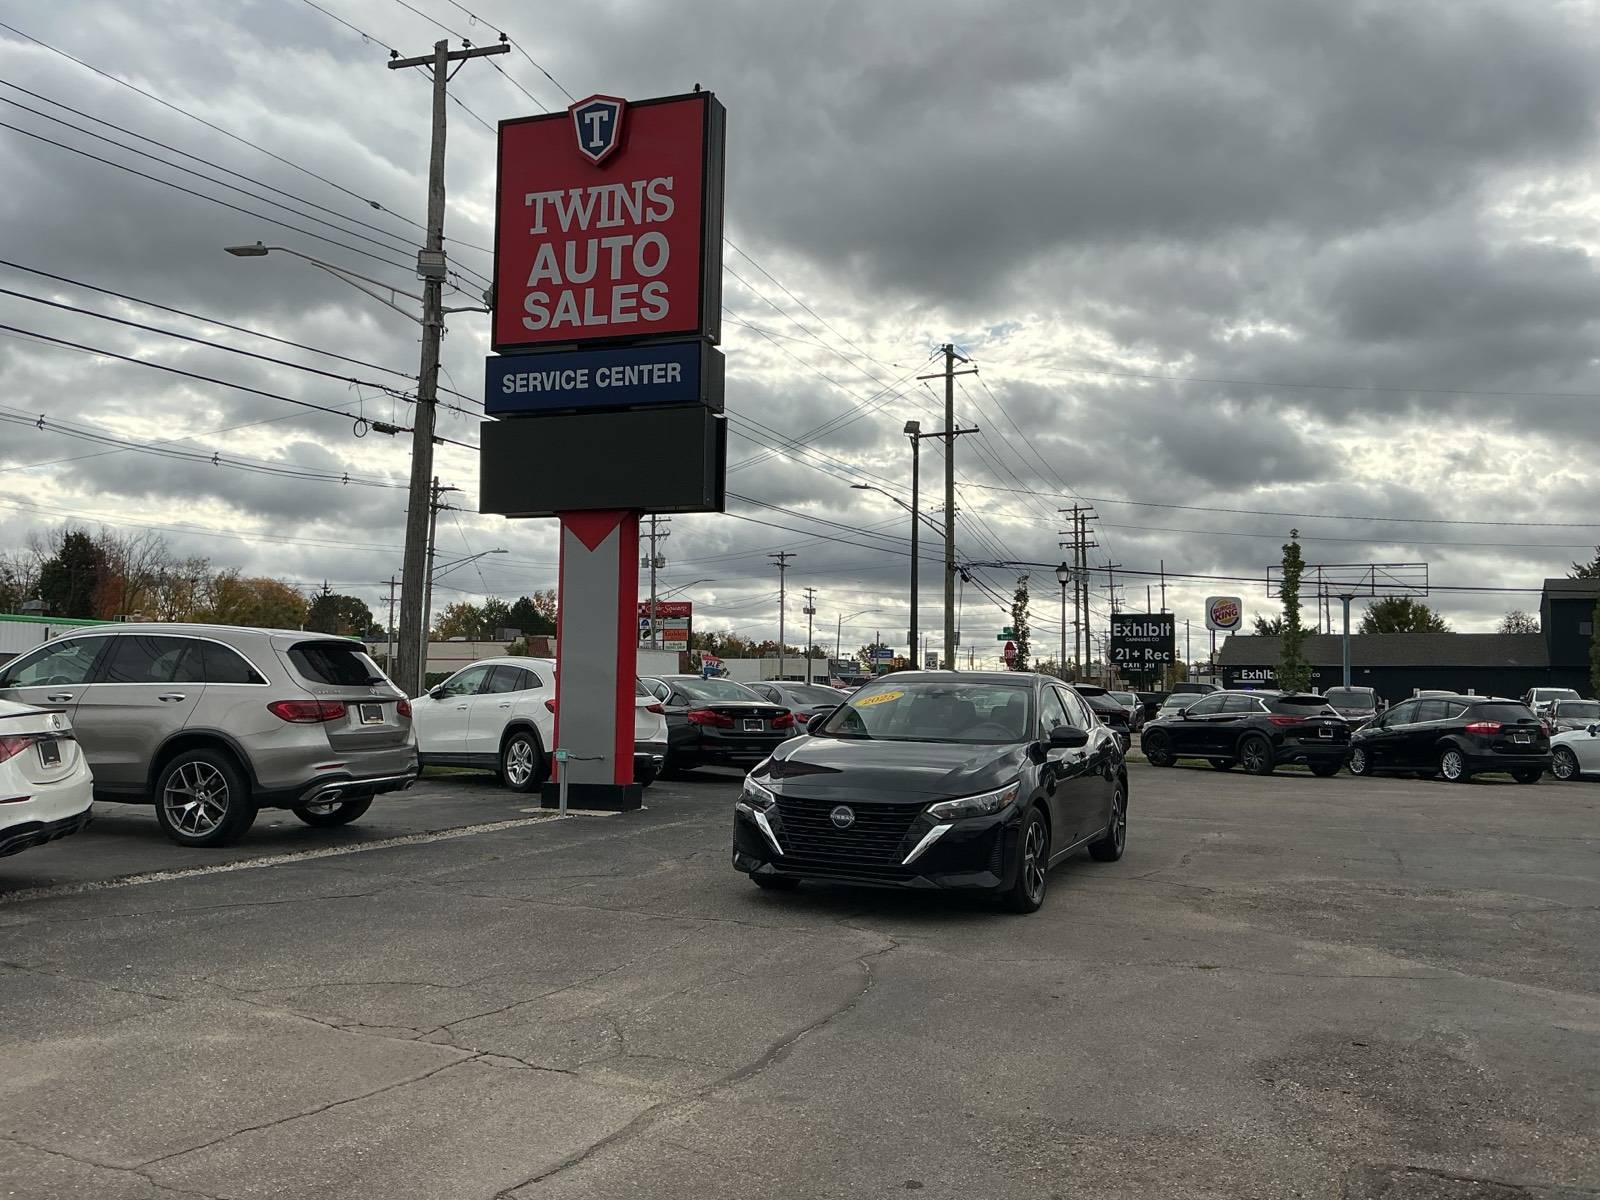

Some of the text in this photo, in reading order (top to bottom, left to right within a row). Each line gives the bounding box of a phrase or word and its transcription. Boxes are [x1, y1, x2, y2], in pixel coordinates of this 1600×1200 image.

[584, 110, 608, 148] T
[525, 176, 674, 235] TWINS
[526, 232, 670, 287] AUTO
[522, 281, 670, 330] SALES
[502, 362, 681, 394] SERVICE CENTER
[1214, 608, 1238, 621] KING
[1113, 622, 1171, 637] Exhibit
[1145, 648, 1169, 660] Rec
[705, 660, 721, 669] SALE
[926, 660, 937, 668] 45
[863, 694, 896, 705] 2025
